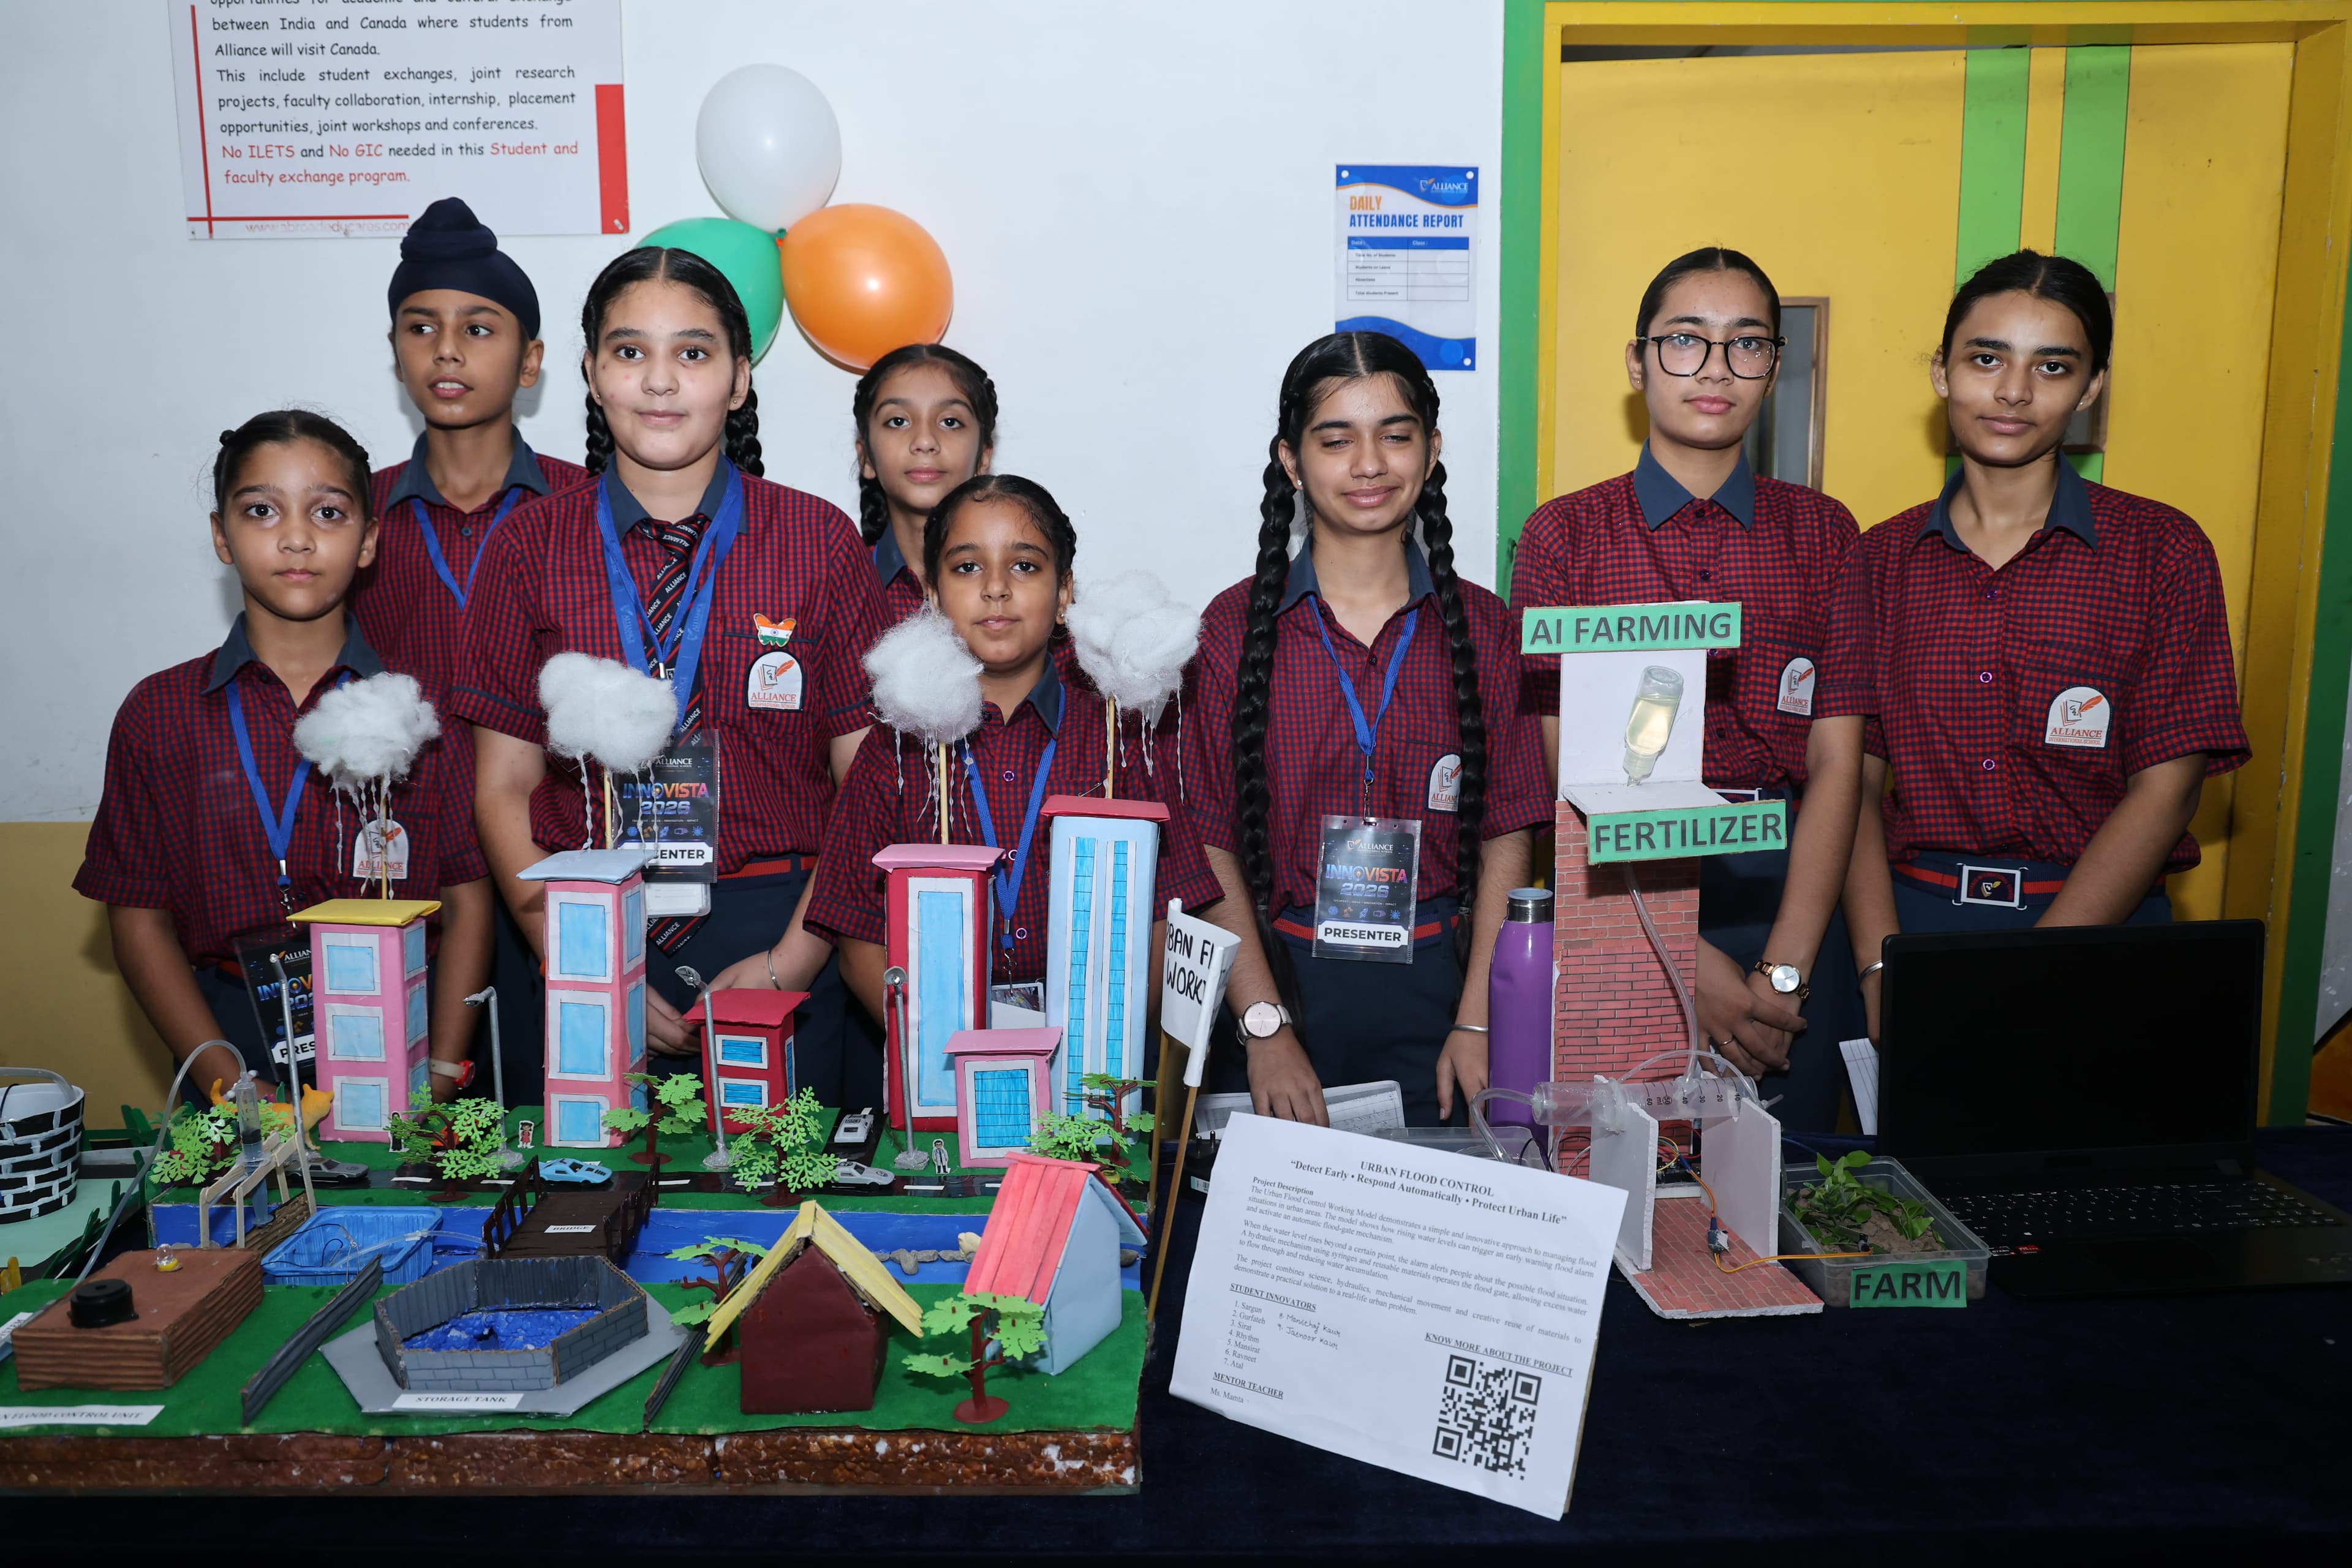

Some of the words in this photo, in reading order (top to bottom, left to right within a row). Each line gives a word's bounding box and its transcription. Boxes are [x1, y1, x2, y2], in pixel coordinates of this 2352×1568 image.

[213, 18, 269, 30] between
[279, 17, 315, 29] India
[326, 17, 349, 29] and
[360, 16, 406, 29] Canada
[418, 15, 458, 28] where
[470, 15, 528, 28] students
[540, 14, 572, 27] from
[215, 43, 267, 56] Alliance
[271, 43, 292, 55] will
[297, 43, 325, 55] visit
[330, 42, 379, 55] Canada.
[216, 69, 244, 81] This
[260, 69, 305, 81] include
[318, 68, 369, 81] student
[384, 67, 456, 83] exchanges,
[470, 67, 501, 83] joint
[516, 65, 575, 78] research
[219, 96, 279, 111] projects,
[283, 94, 330, 110] faculty
[335, 93, 424, 107] collaboration,
[429, 92, 499, 108] internship,
[509, 91, 575, 107] placement
[221, 120, 312, 136] opportunities,
[317, 119, 347, 135] joint
[352, 118, 420, 134] workshops
[425, 118, 448, 130] and
[453, 117, 537, 130] conferences.
[222, 146, 241, 158] No
[248, 145, 294, 158] ILETS
[301, 145, 323, 157] and
[330, 145, 349, 157] No
[355, 144, 382, 156] GIC
[389, 143, 435, 156] needed
[442, 144, 453, 155] in
[458, 143, 484, 155] this
[491, 142, 546, 155] Student
[554, 141, 578, 154] and
[224, 170, 274, 186] faculty
[279, 169, 344, 186] exchange
[349, 172, 409, 186] program.
[1350, 196, 1382, 210] DAILY
[1350, 214, 1418, 227] ATTENDANCE
[1423, 215, 1464, 227] REPORT
[665, 571, 687, 594] ALLIANCE
[654, 612, 672, 635] LLIANCE
[1530, 618, 1562, 646] AI
[1575, 612, 1732, 643] FARMING
[751, 692, 796, 701] ALLIANCE
[1781, 696, 1809, 707] ALLIANCE
[679, 707, 701, 733] ALLIANCE
[2051, 727, 2103, 737] ALLIANCE
[641, 801, 690, 815] 2026
[1595, 813, 1782, 853] FERTILIZER
[1358, 843, 1393, 851] ALLIANCE
[1325, 864, 1408, 883] INNOVISTA
[1340, 883, 1389, 898] 2026
[656, 922, 680, 946] ALLIANCE
[1324, 927, 1401, 942] PRESENTER
[1253, 1176, 1275, 1186] Project
[1277, 1182, 1313, 1195] Description
[1360, 1161, 1396, 1175] URBAN
[1400, 1169, 1437, 1184] FLOOD
[1440, 1178, 1492, 1196] CONTROL
[1291, 1160, 1322, 1174] “Detect
[1324, 1167, 1348, 1180] Early
[1357, 1174, 1395, 1189] Respond
[1398, 1183, 1461, 1205] Automatically
[1472, 1197, 1505, 1212] Protect
[1509, 1205, 1537, 1219] Urban
[1542, 1212, 1566, 1223] Life”
[1251, 1185, 1262, 1194] The
[1264, 1188, 1282, 1198] Urban
[1283, 1193, 1302, 1202] Flood
[1302, 1197, 1325, 1208] Control
[1327, 1202, 1354, 1216] Working
[1356, 1208, 1377, 1219] Model
[1378, 1213, 1420, 1229] demonstrates
[1428, 1225, 1450, 1235] simple
[1465, 1233, 1500, 1246] innovative
[1501, 1242, 1532, 1253] approach
[1542, 1251, 1577, 1264] managing
[1578, 1257, 1596, 1267] flood
[1854, 1270, 1961, 1300] FARM
[1230, 1283, 1264, 1297] STUDENT
[1265, 1292, 1316, 1310] INNOVATORS
[1241, 1302, 1262, 1313] Sargun
[1237, 1321, 1251, 1331] Sirat
[1239, 1312, 1265, 1324] Gurfateh
[1235, 1330, 1259, 1343] Rhythm
[1234, 1340, 1259, 1353] Mansirat
[1425, 1332, 1452, 1344] KNOW
[1454, 1340, 1480, 1352] MORE
[1482, 1348, 1512, 1360] ABOUT
[1514, 1354, 1531, 1365] THE
[1533, 1359, 1572, 1375] PROJECT
[1232, 1349, 1256, 1362] Ravneet
[1230, 1360, 1243, 1369] Atal
[1213, 1371, 1245, 1387] MENTOR
[1248, 1381, 1283, 1398] TEACHER
[1210, 1387, 1221, 1396] Ms.
[1223, 1391, 1243, 1403] Mamta
